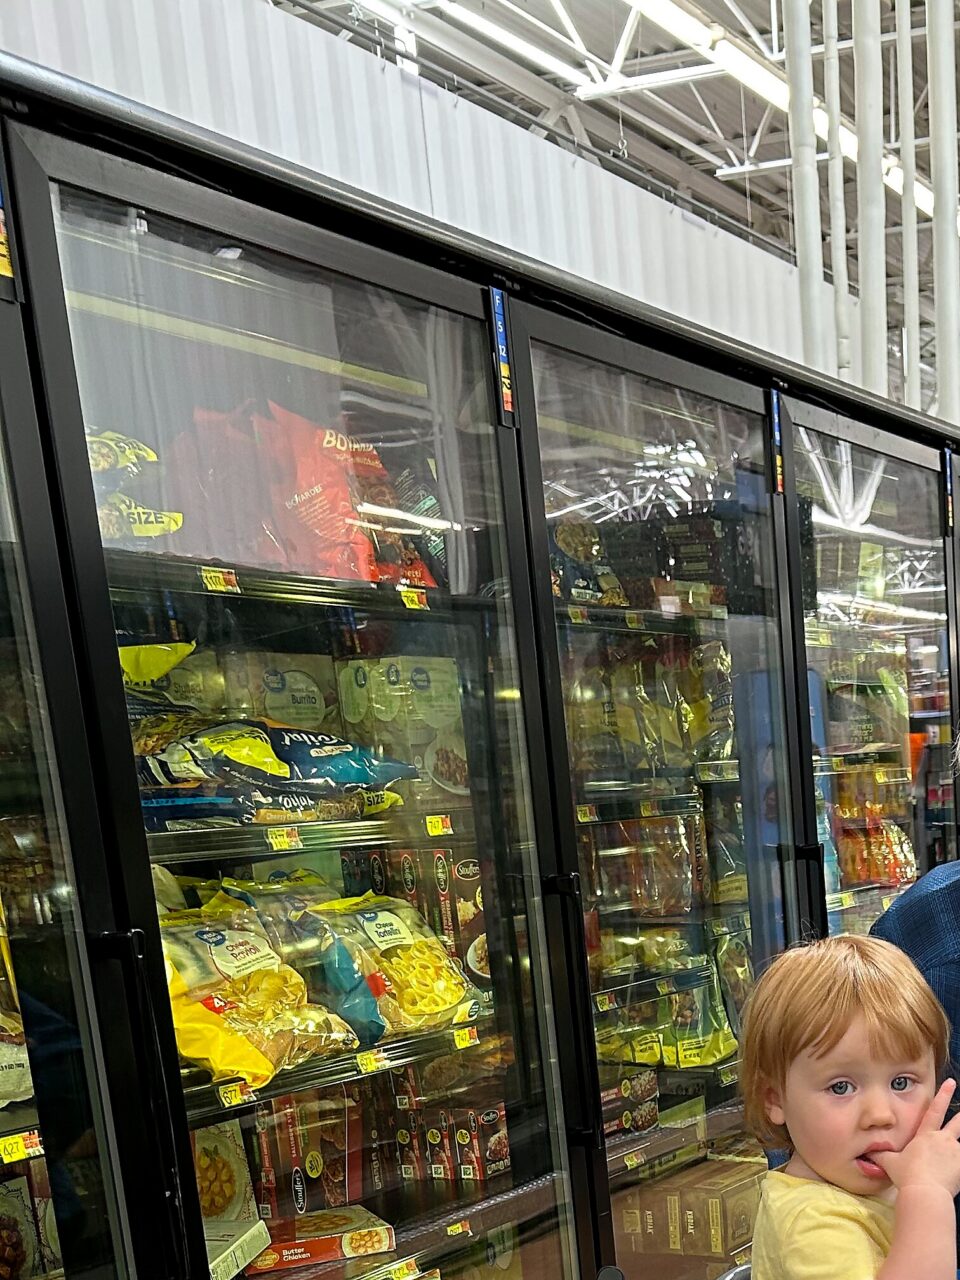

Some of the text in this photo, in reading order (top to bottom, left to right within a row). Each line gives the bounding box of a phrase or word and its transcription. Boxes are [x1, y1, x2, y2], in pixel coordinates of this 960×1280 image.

[126, 511, 165, 525] SIZE
[291, 694, 317, 705] Burrito
[222, 1089, 237, 1105] 677
[3, 1141, 20, 1159] 427
[282, 1247, 305, 1256] Butter
[283, 1252, 311, 1262] Chicken
